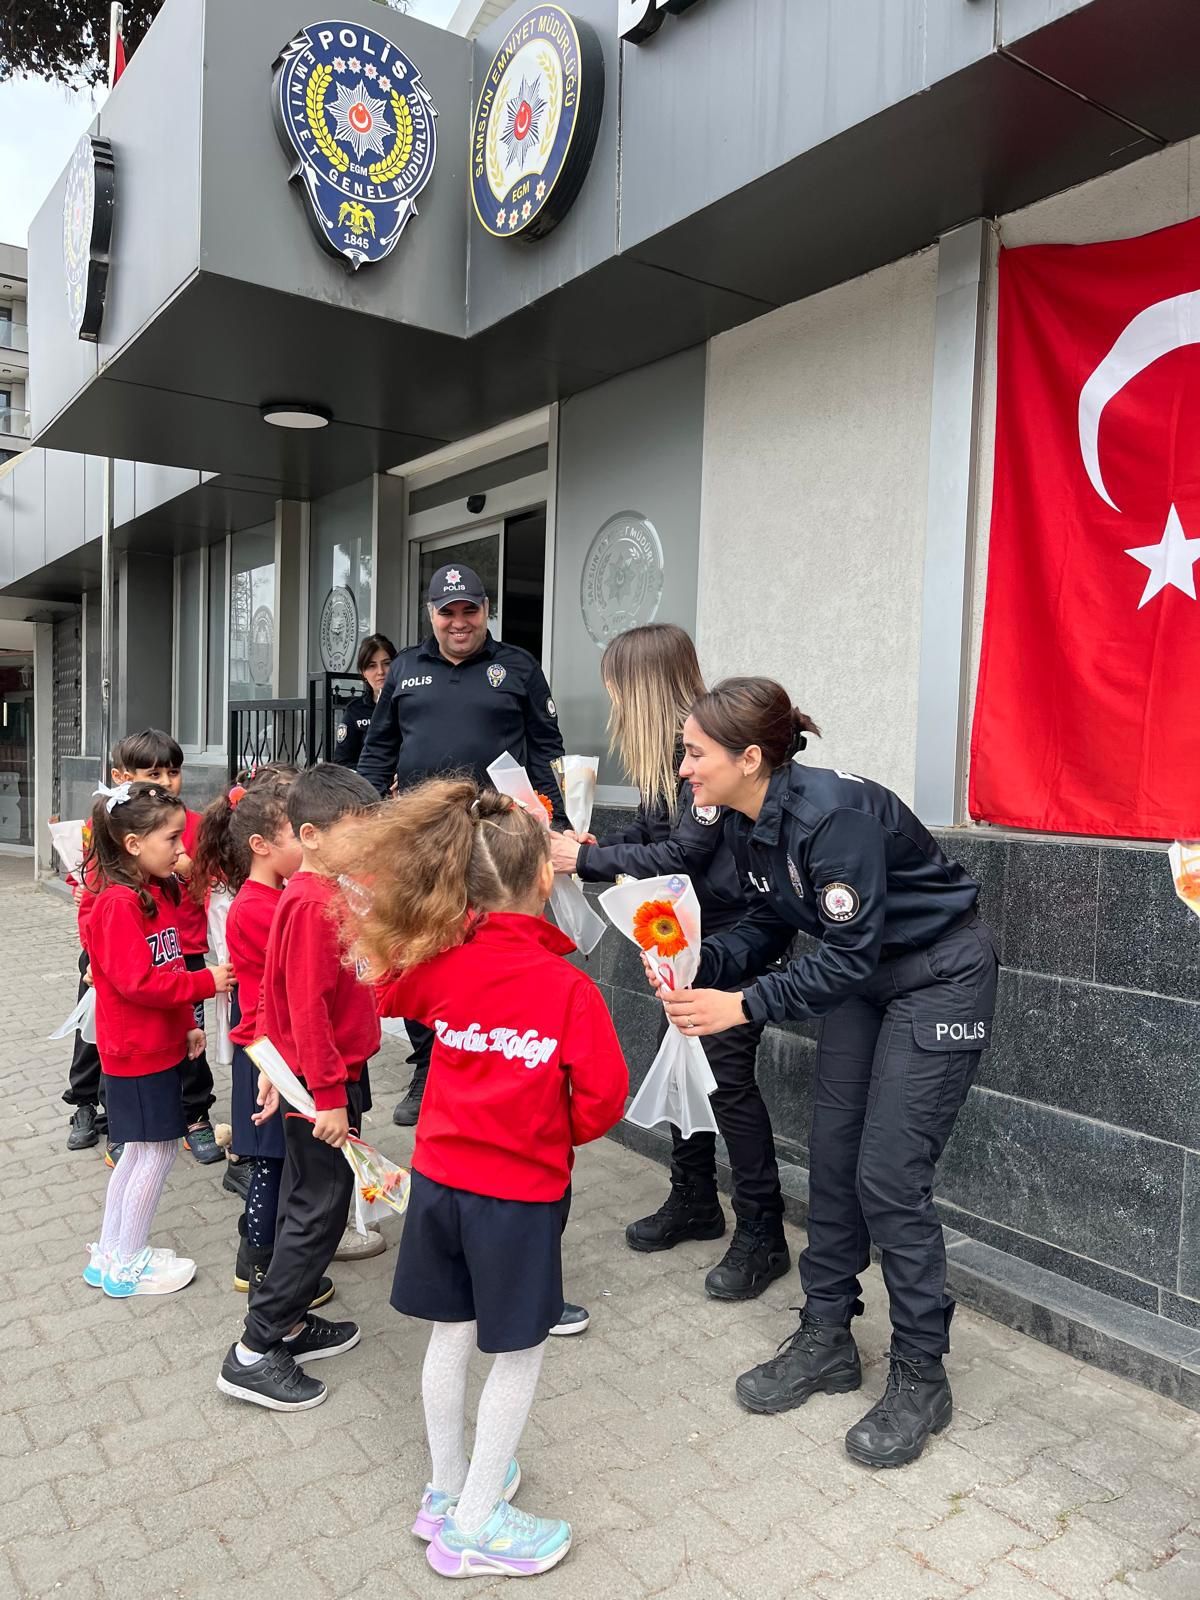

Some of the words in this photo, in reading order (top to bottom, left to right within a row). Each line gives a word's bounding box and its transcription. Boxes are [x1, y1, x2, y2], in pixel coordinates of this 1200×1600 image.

[318, 29, 407, 79] POLİS
[476, 90, 493, 178] SAMSUN
[492, 18, 537, 85] EMNİYET
[538, 13, 577, 107] MÜDÜRLÜĞÜ
[291, 50, 320, 157] EMNİYET
[329, 168, 387, 199] GENEL
[393, 92, 427, 193] MÜDÜRLÜĞÜ
[350, 162, 368, 177] EGM
[512, 181, 530, 203] EGM
[344, 232, 369, 249] 1845
[401, 675, 433, 689] POLİS
[936, 1021, 985, 1041] POLİS
